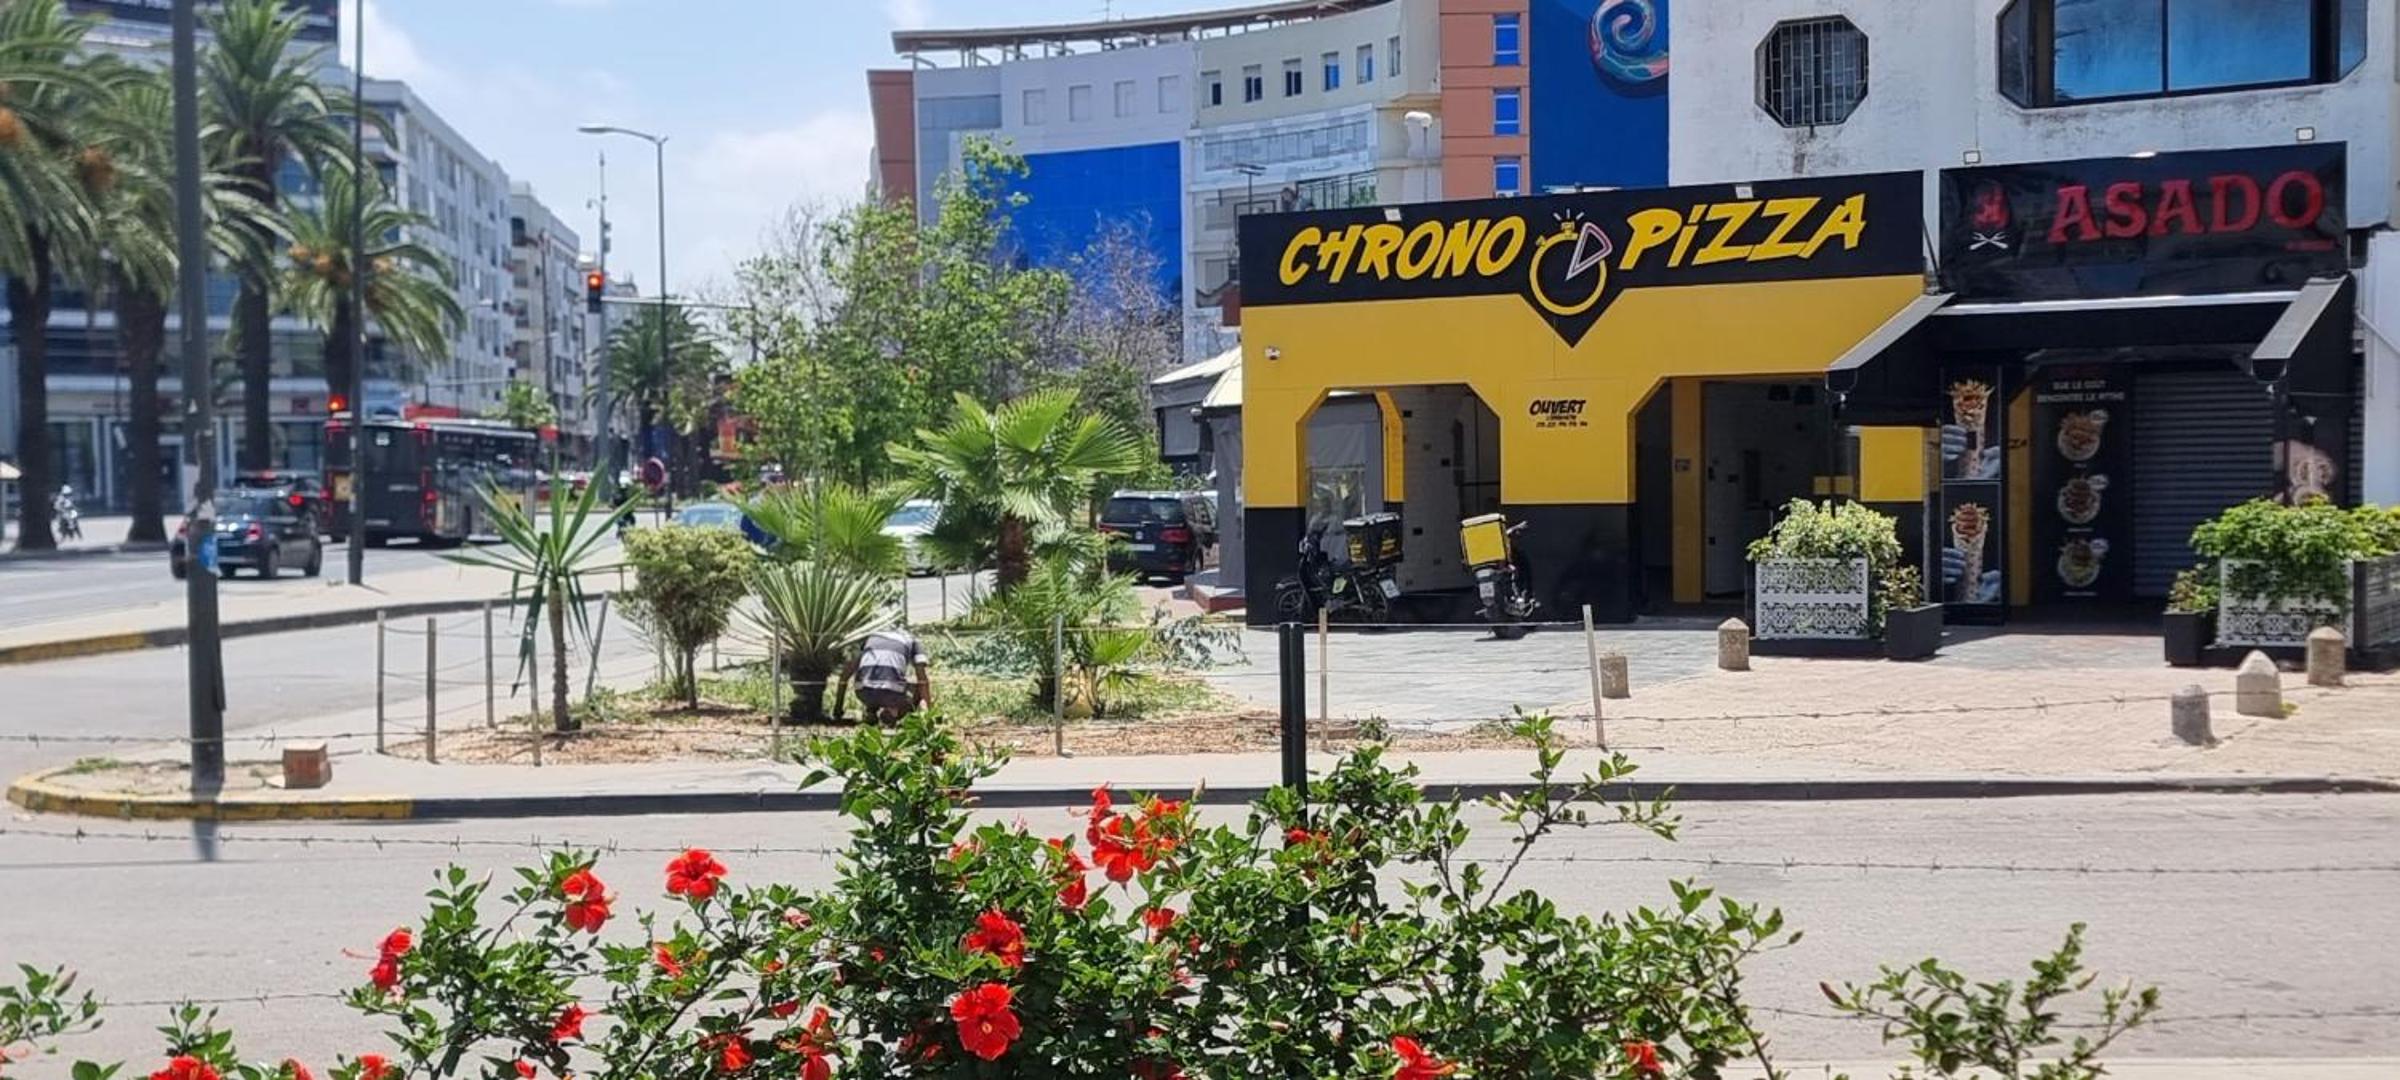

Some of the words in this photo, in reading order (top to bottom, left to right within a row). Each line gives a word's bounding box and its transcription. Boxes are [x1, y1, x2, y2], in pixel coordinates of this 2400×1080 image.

[2047, 170, 2324, 243] ASADO
[1279, 215, 1526, 285] CHRONO
[1529, 399, 1586, 416] OUVERT
